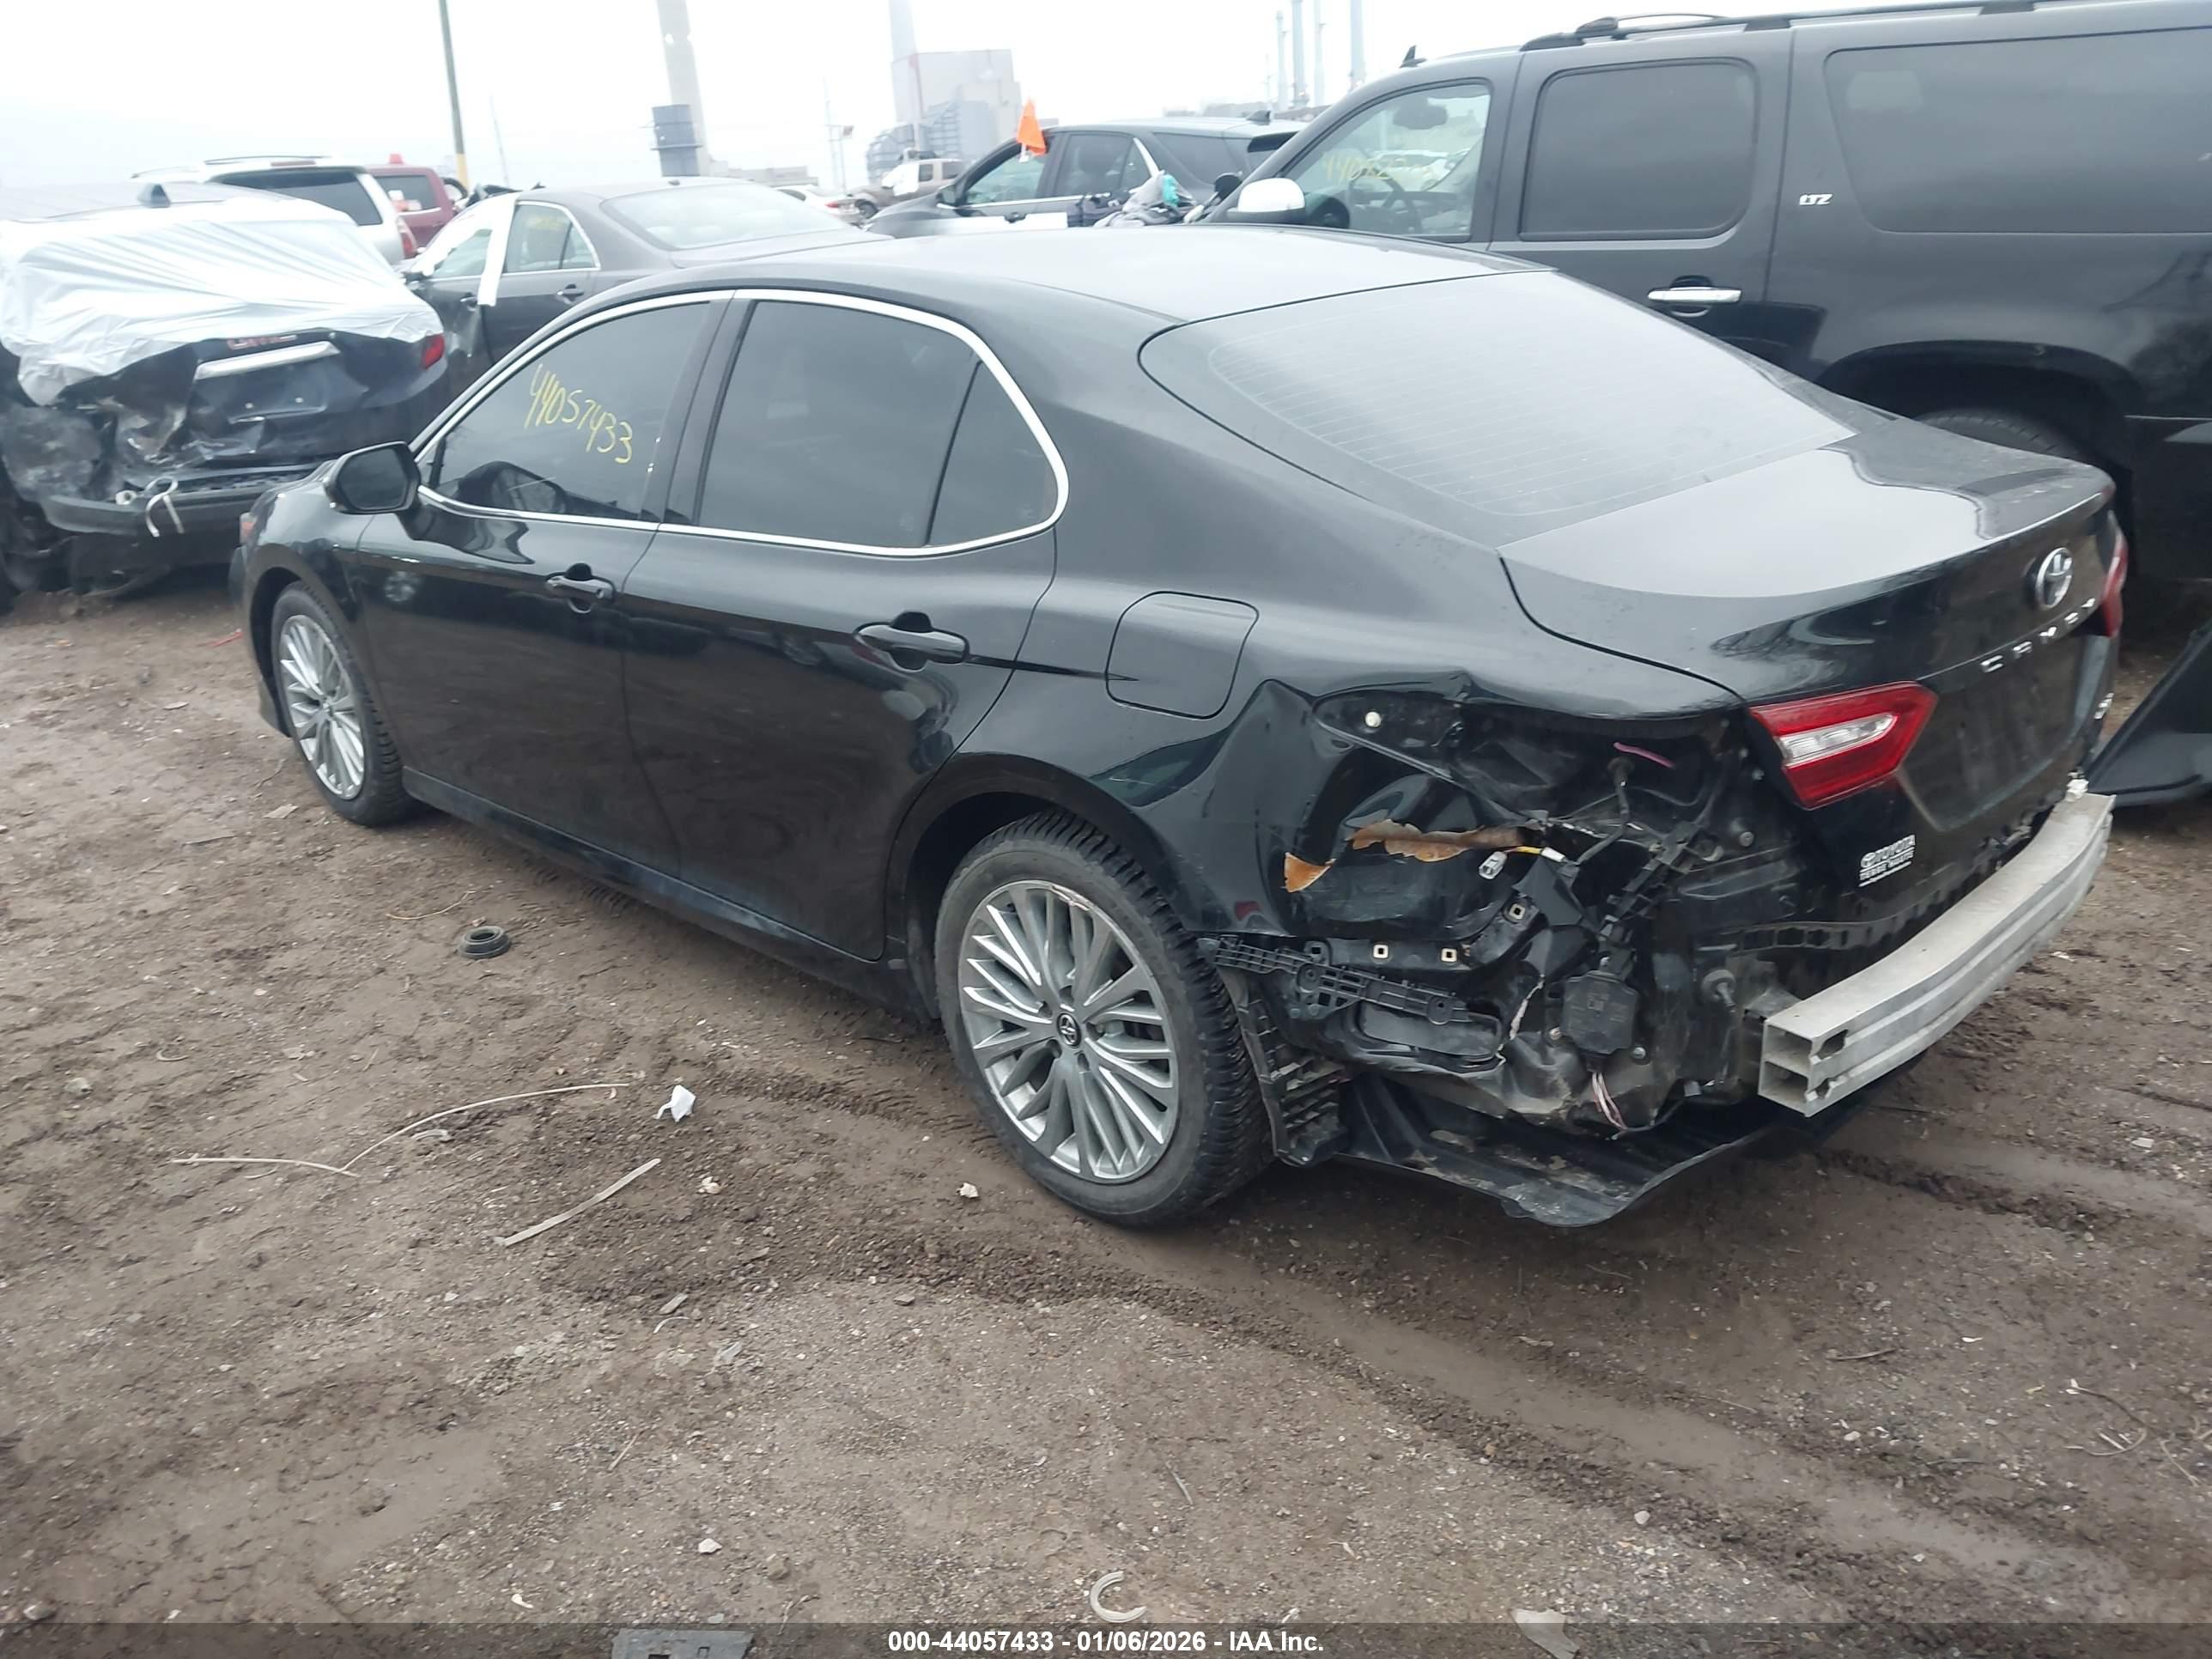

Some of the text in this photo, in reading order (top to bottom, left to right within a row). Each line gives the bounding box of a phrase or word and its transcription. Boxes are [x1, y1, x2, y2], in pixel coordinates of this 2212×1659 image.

[1799, 193, 1832, 205] LTZ
[524, 363, 634, 464] 44057433
[1980, 597, 2096, 673] CAMRY
